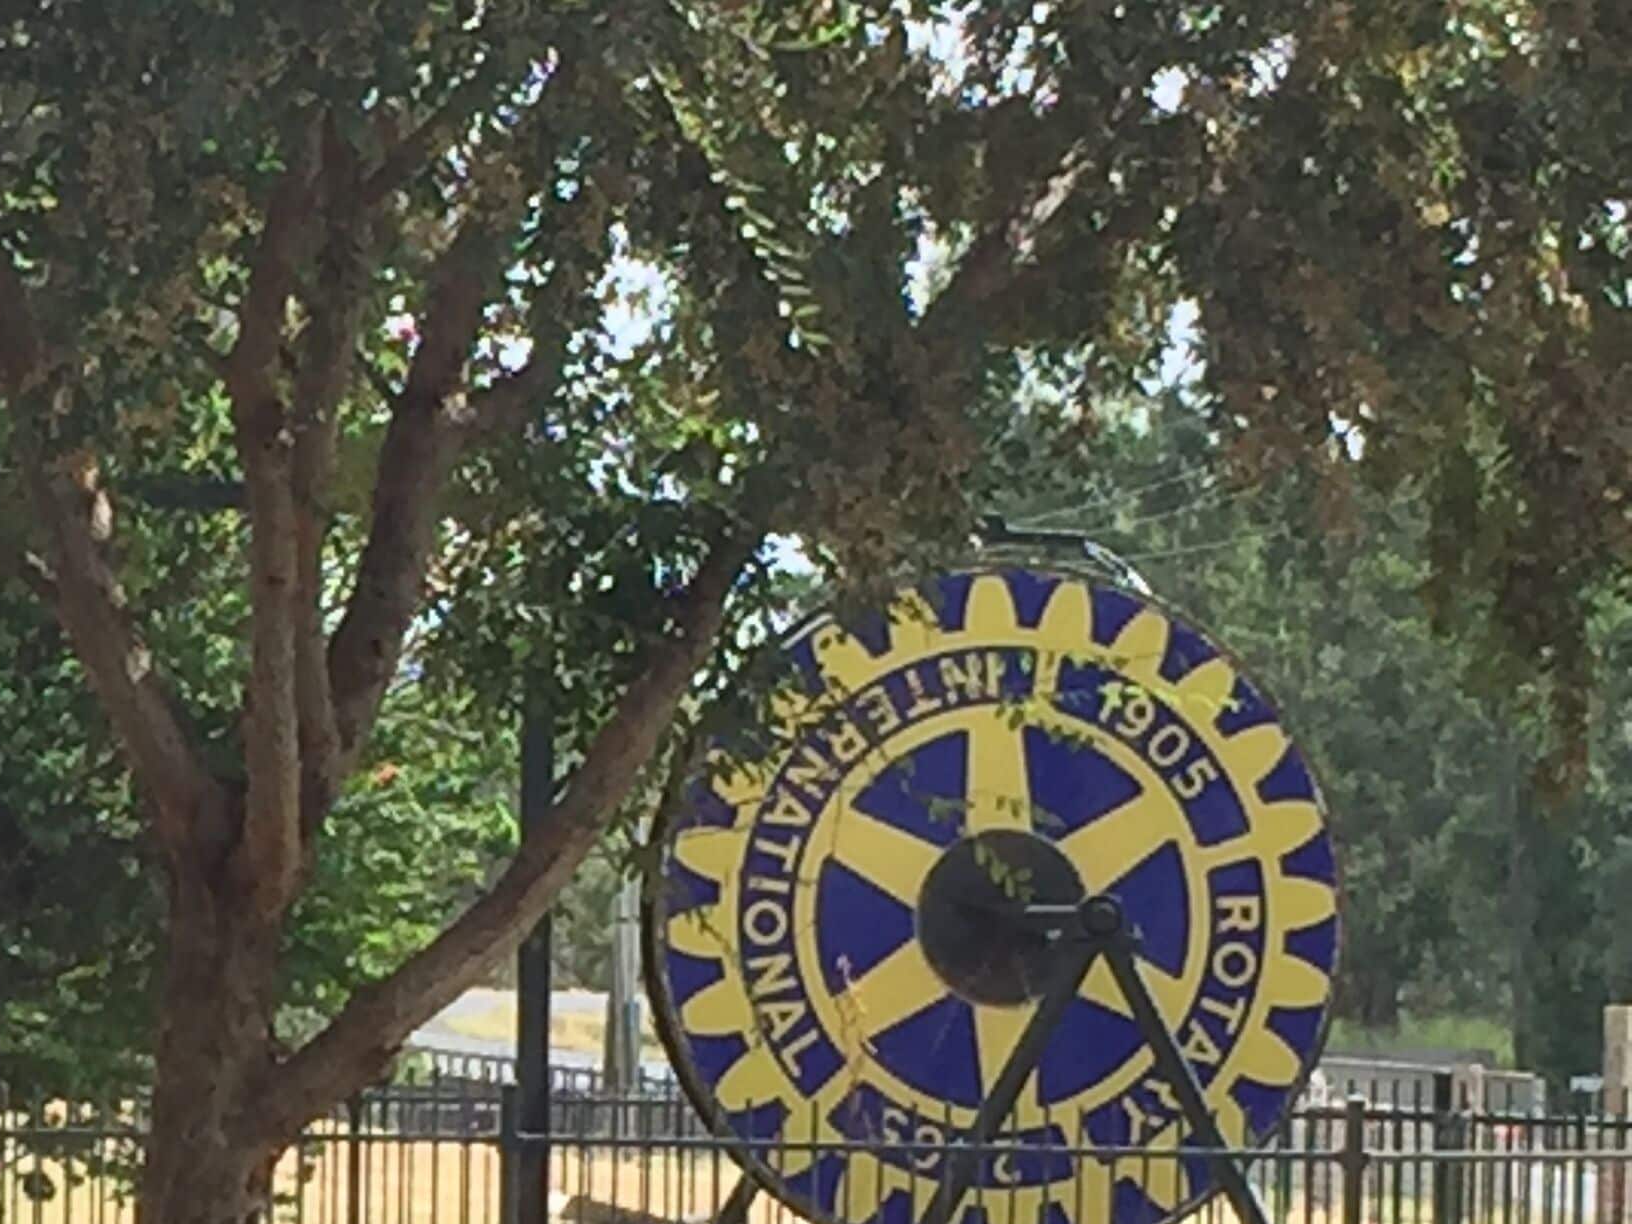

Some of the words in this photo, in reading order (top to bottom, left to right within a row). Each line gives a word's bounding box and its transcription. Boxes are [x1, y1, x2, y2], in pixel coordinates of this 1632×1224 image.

[1098, 683, 1218, 799] 1905
[743, 652, 1002, 1078] INTERNATIONAL
[883, 1108, 1022, 1184] 205
